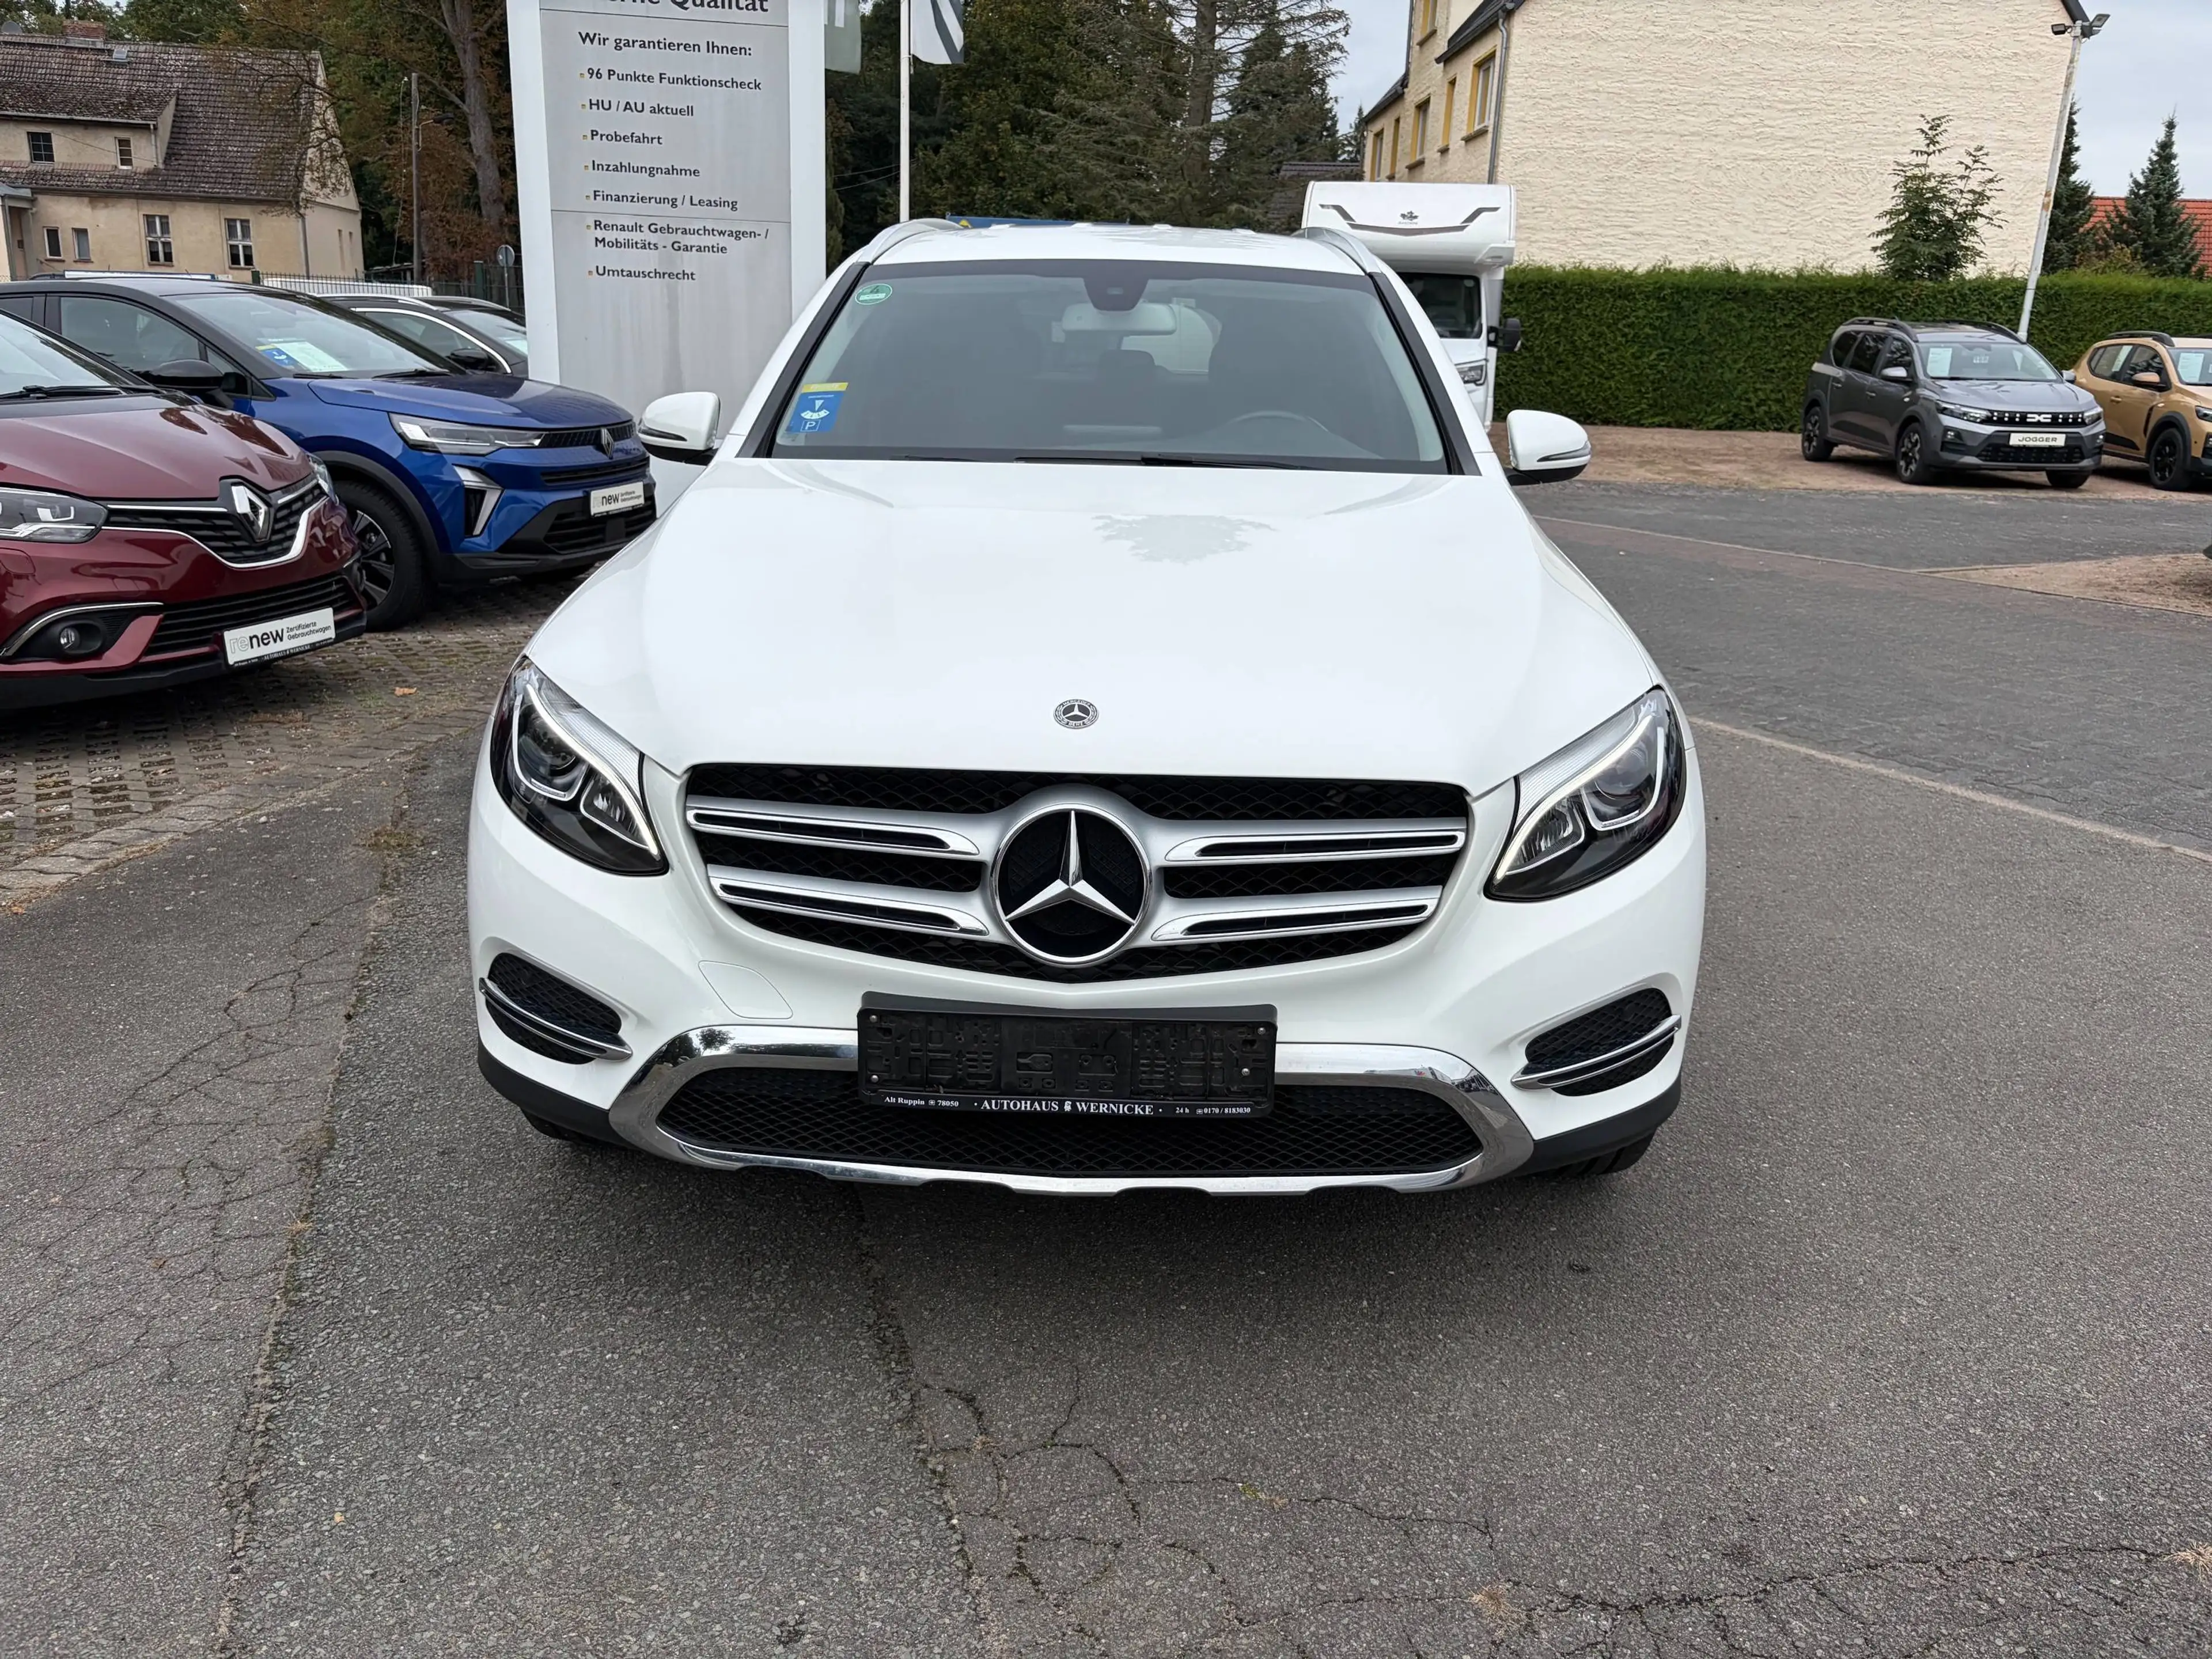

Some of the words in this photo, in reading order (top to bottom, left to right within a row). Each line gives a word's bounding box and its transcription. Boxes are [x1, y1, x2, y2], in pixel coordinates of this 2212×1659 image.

[578, 31, 609, 46] Wir
[614, 37, 701, 53] garantieren
[706, 40, 752, 56] Ihnen:
[587, 67, 603, 79] 96
[607, 69, 654, 84] Punkte
[658, 72, 762, 90] Funktionscheck
[589, 98, 612, 111] HU
[616, 100, 620, 112] /
[623, 101, 645, 113] AU
[649, 104, 694, 116] aktuell
[590, 129, 662, 145] Probefahrt
[592, 160, 700, 178] Inzahlungnahme
[593, 190, 678, 209] Finanzierung
[681, 195, 685, 206] /
[690, 195, 738, 212] Leasing
[594, 219, 644, 233] Renault
[648, 222, 762, 241] Gebrauchtwagen-
[594, 237, 659, 251] Mobilitäts
[671, 241, 728, 254] Garantie
[596, 265, 696, 281] Umtauschrecht
[805, 421, 816, 430] P
[286, 621, 317, 633] Zertifizierte
[287, 625, 331, 641] Gebrauchtwagen
[229, 627, 284, 654] renew
[897, 1097, 925, 1105] Ruppin
[981, 1100, 1059, 1112] AUTOHAUS
[1076, 1102, 1154, 1115] WERNICKE
